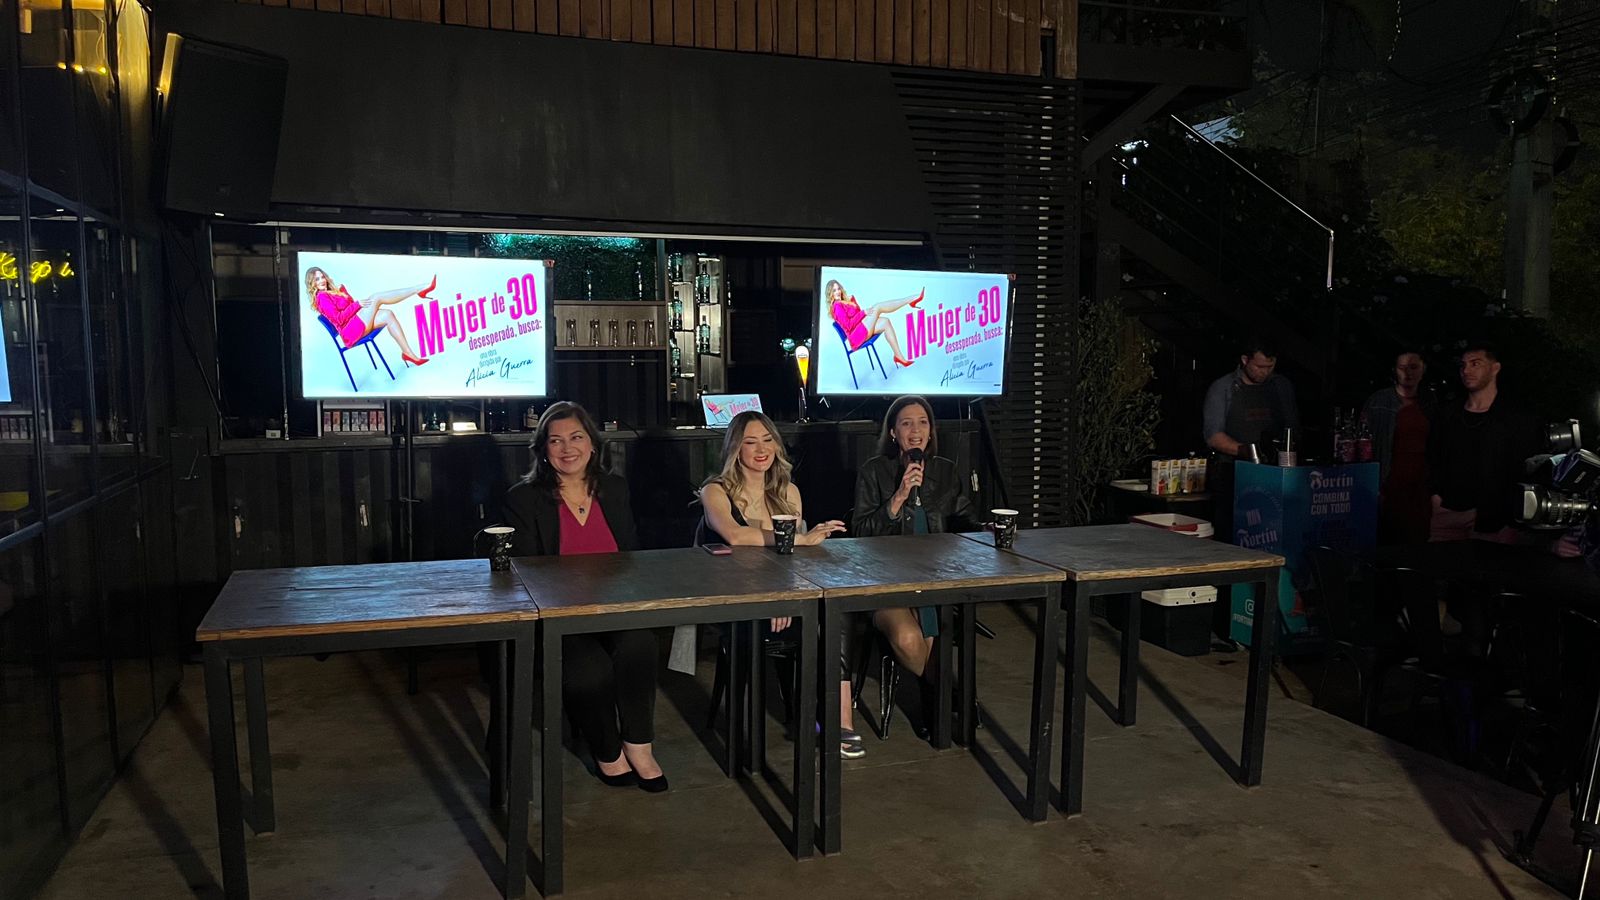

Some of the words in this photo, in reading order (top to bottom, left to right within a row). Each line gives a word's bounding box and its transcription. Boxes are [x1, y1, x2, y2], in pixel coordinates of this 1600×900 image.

[414, 292, 488, 358] Mujer
[491, 292, 506, 315] de
[506, 273, 538, 320] 30
[905, 303, 962, 360] Mujer
[965, 302, 976, 322] de
[977, 285, 1001, 327] 30
[468, 325, 517, 351] desesperada,
[517, 319, 543, 336] busca:
[983, 326, 1003, 341] busca:
[466, 367, 497, 388] Alicia
[499, 357, 534, 379] Guerra
[1310, 504, 1328, 516] CON
[1330, 502, 1351, 514] TODO
[1312, 491, 1351, 506] COMBINA
